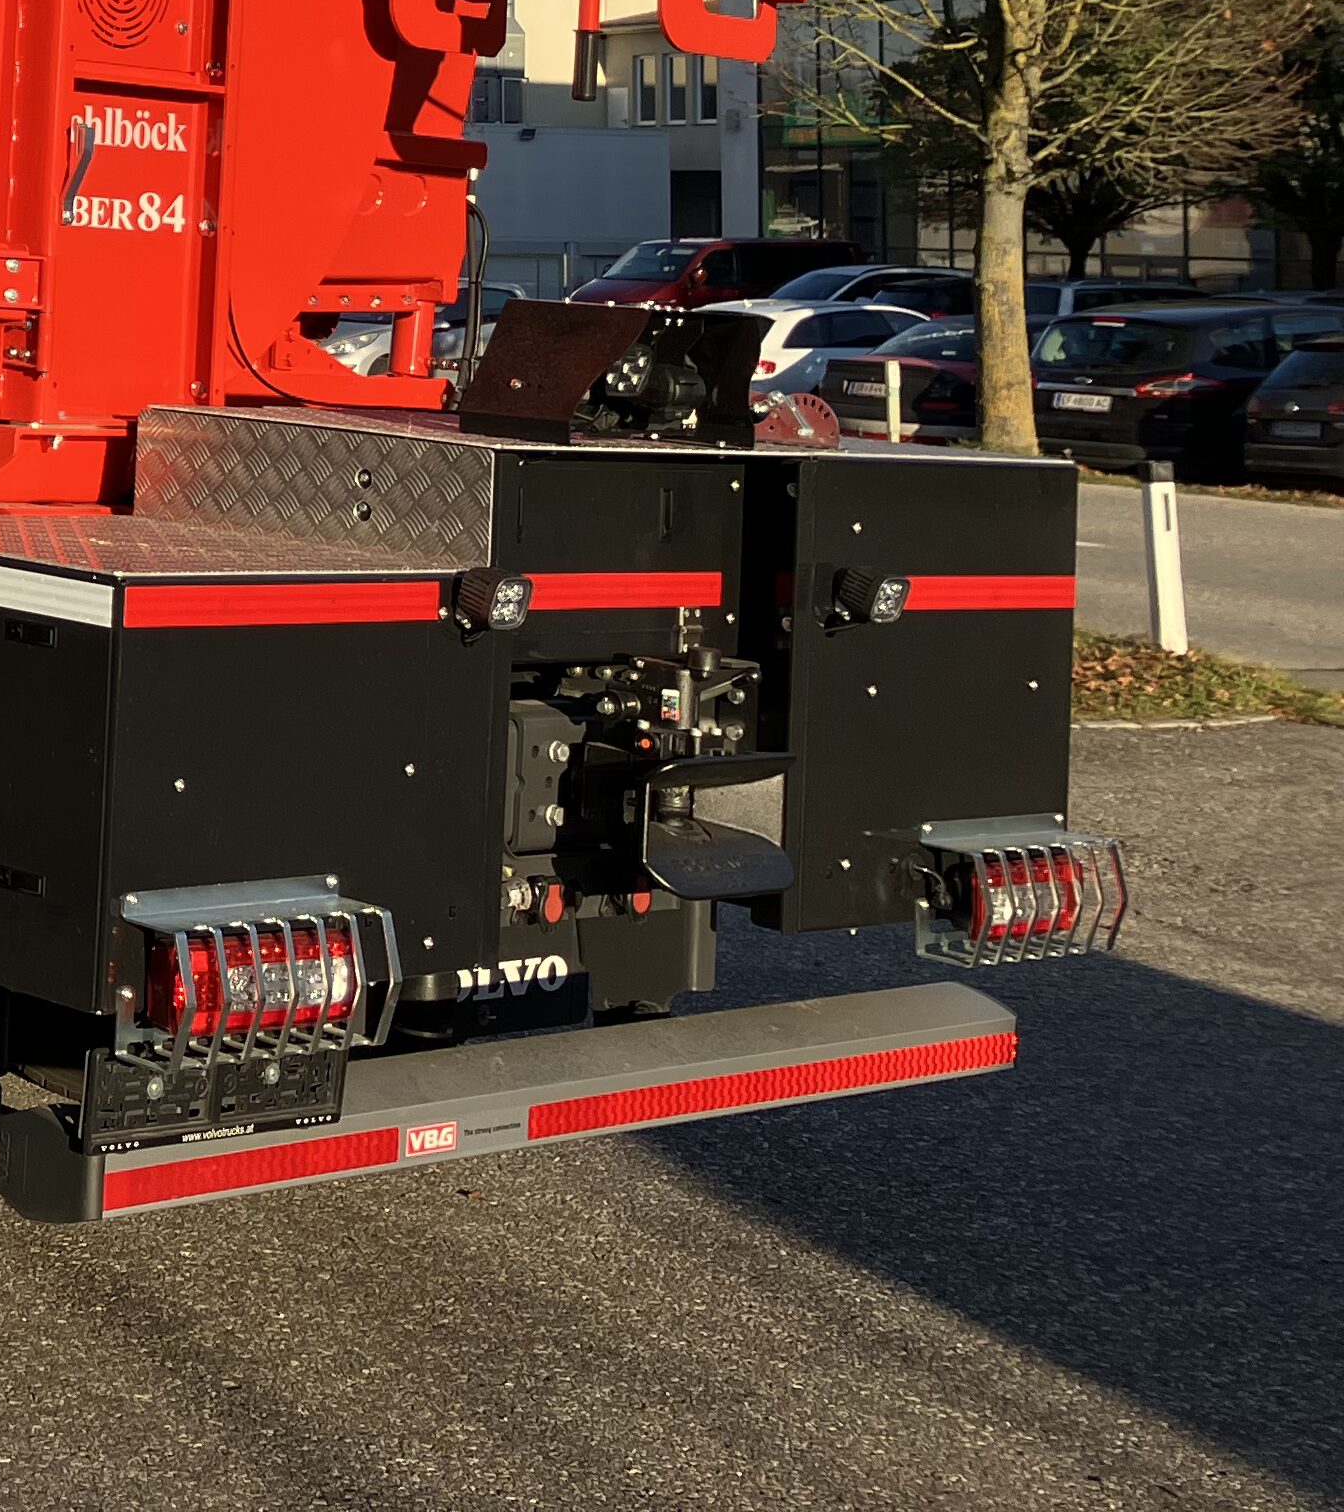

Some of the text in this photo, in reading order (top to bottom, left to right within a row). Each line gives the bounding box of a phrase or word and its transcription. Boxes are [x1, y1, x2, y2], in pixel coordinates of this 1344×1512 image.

[70, 105, 187, 152] chlböck
[72, 192, 186, 233] BER 84
[295, 1114, 332, 1125] VOLVO
[181, 1123, 255, 1143] www.volvotrucks.at
[409, 1127, 455, 1152] VBG
[100, 1141, 140, 1152] VOLVO
